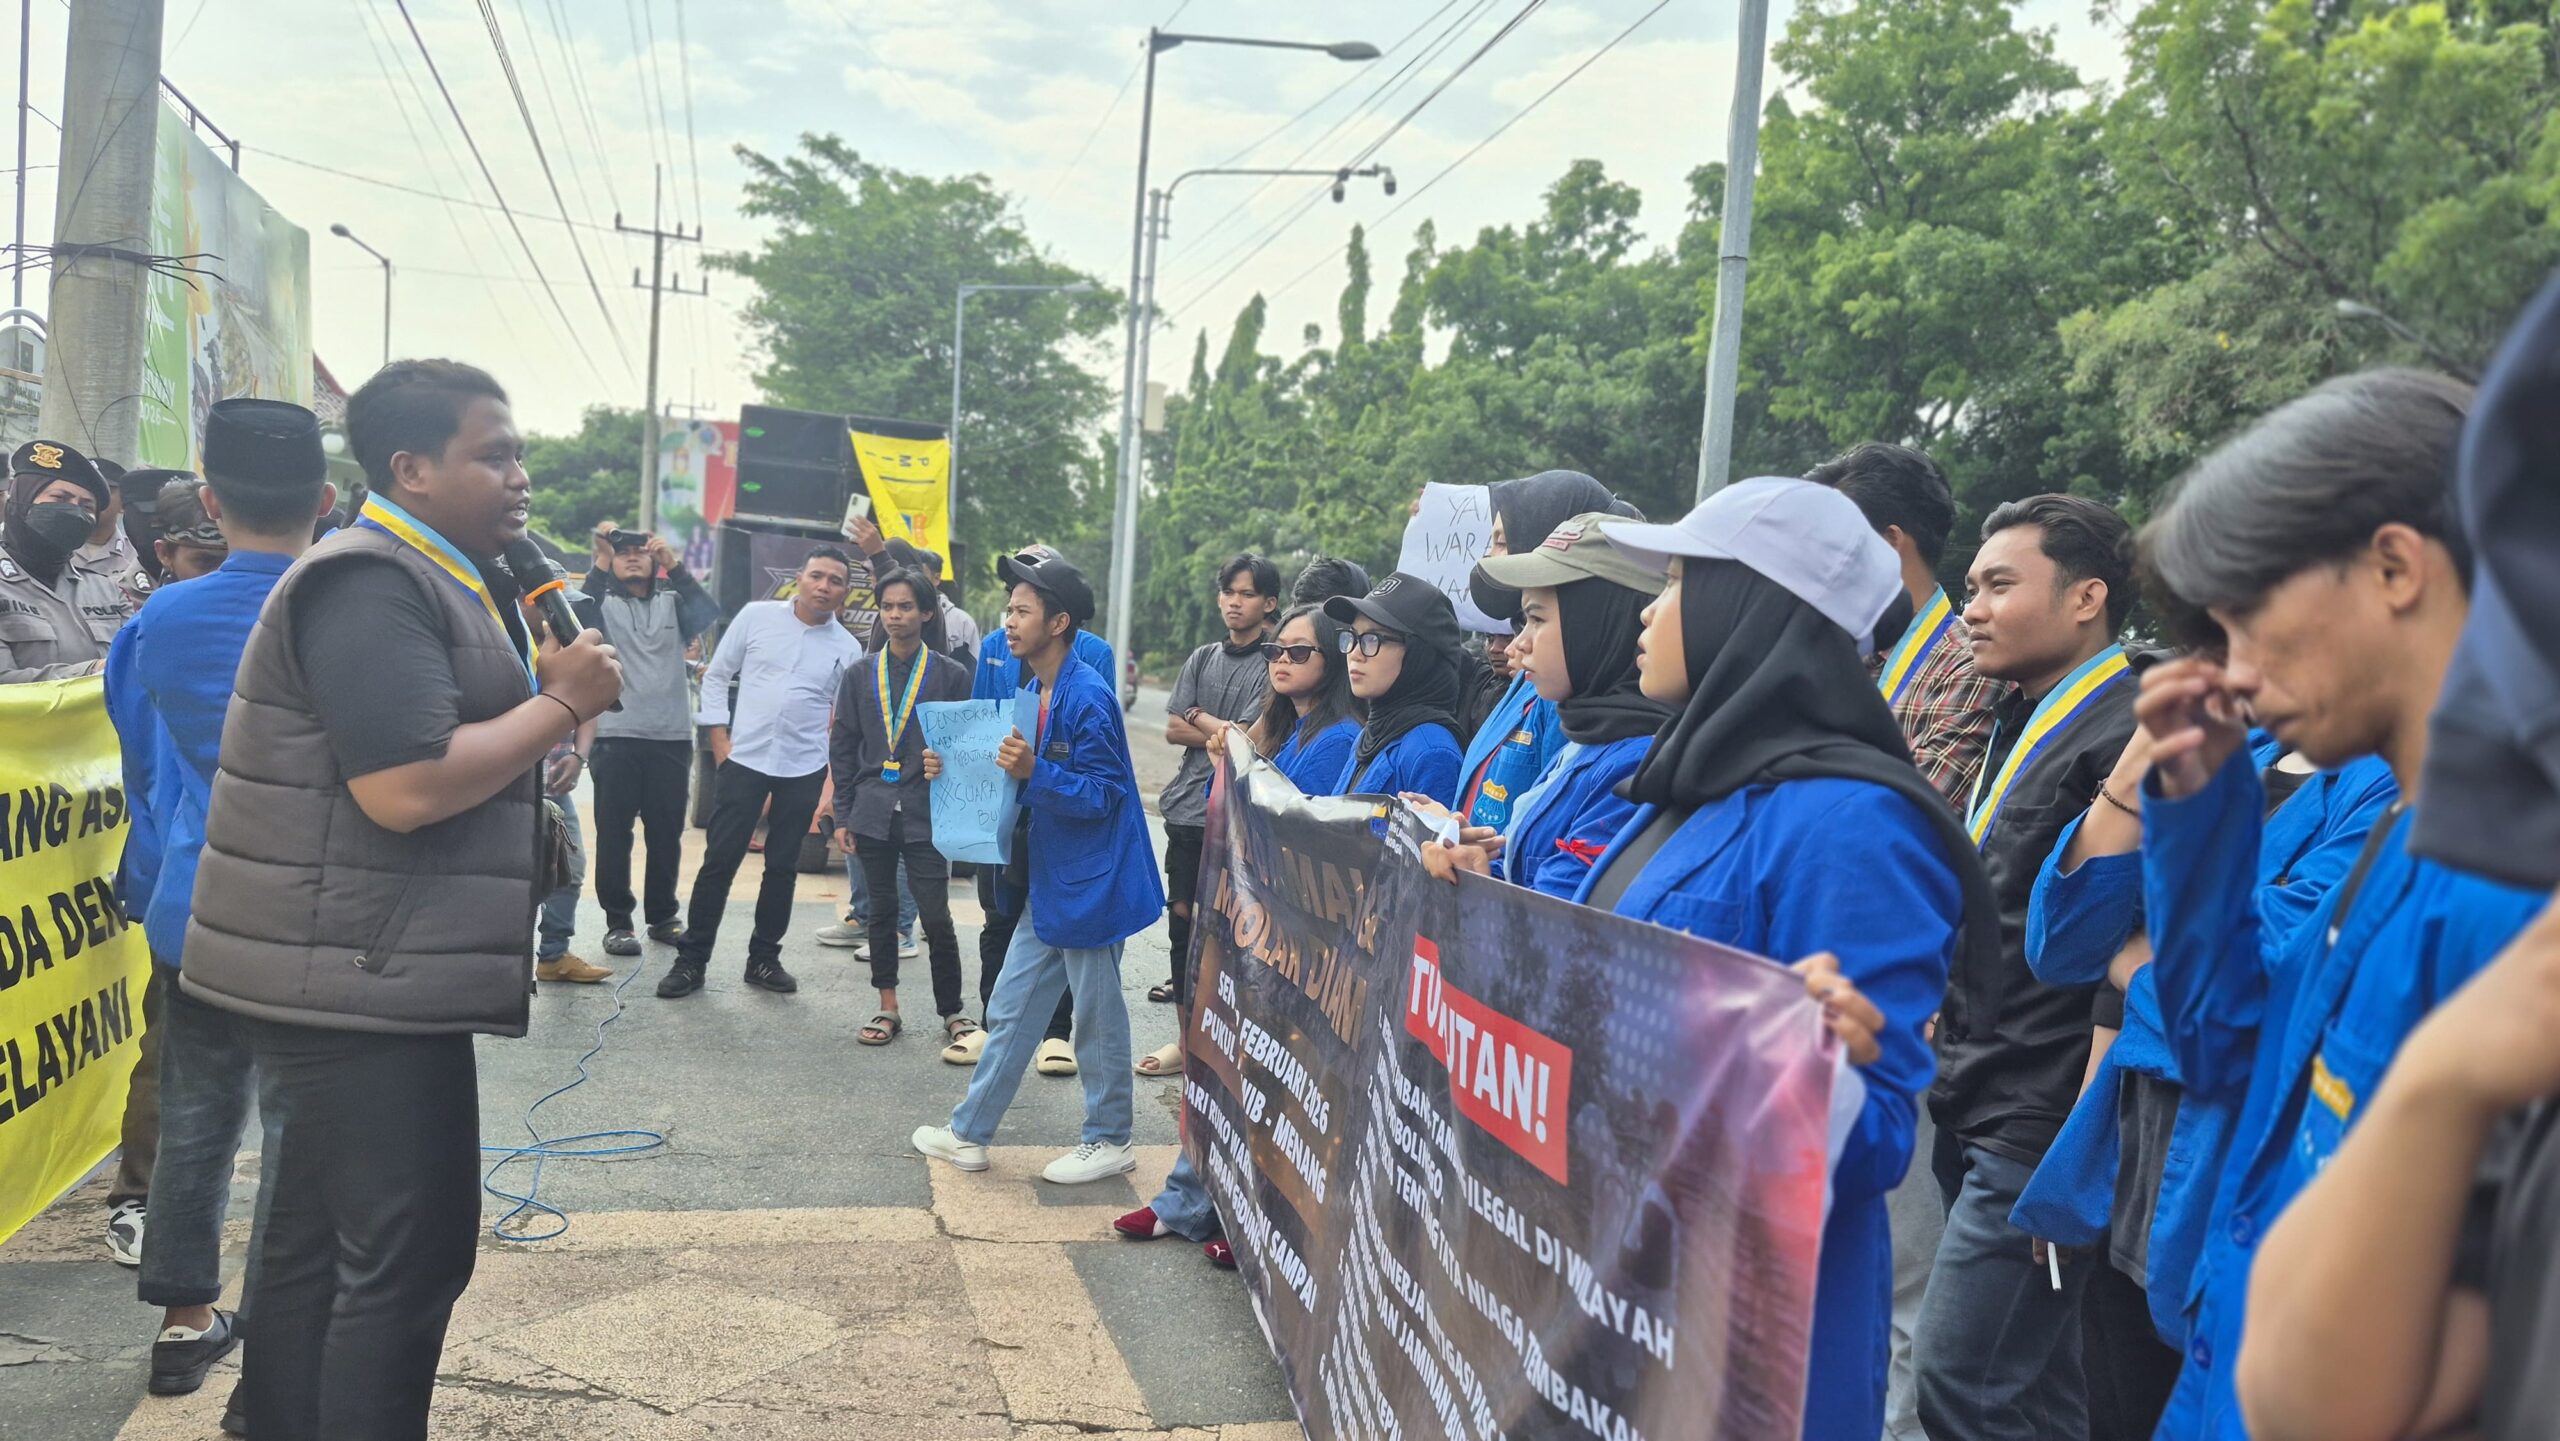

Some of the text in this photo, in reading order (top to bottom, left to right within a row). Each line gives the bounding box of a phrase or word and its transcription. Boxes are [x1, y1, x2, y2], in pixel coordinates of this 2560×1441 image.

[977, 808, 1000, 826] BU
[1201, 1007, 1236, 1063] PUKUL
[1272, 1111, 1328, 1205] MENANG
[1239, 1017, 1308, 1103] FEBRUARI
[1303, 1078, 1330, 1136] 2026
[1208, 1098, 1230, 1146] RUKO
[1269, 1219, 1319, 1315] SAMPAI
[1232, 1187, 1261, 1258] GEDUNG
[1465, 1271, 1524, 1358] NIAGA
[1467, 1174, 1531, 1254] ILEGAL
[1534, 1226, 1561, 1276] DI
[1565, 1246, 1675, 1371] WILAYAH
[1398, 1321, 1452, 1422] JAMINAN
